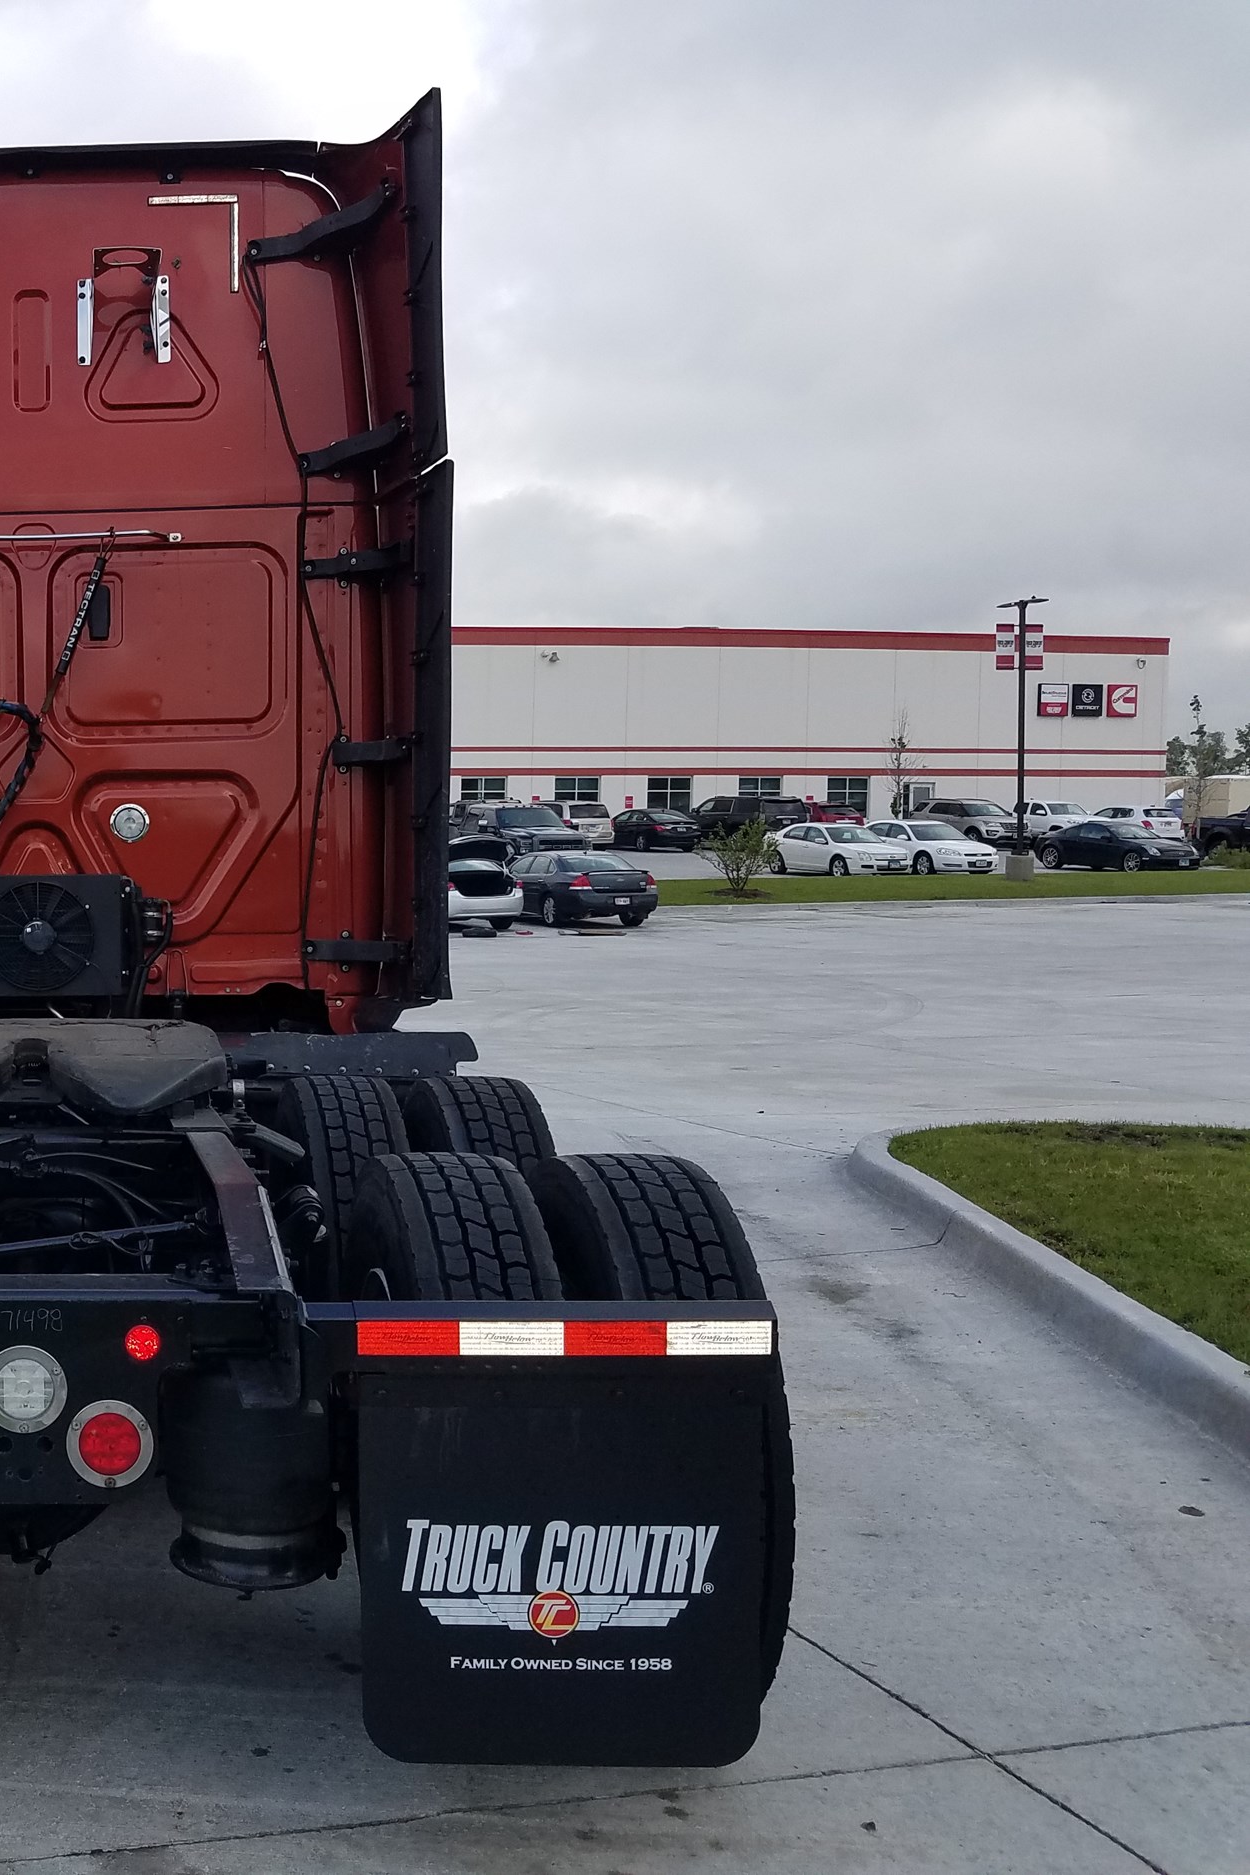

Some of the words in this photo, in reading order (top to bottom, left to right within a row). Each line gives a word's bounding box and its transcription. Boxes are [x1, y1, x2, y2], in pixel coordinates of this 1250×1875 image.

[66, 583, 96, 649] TECTRAN
[1112, 687, 1134, 704] Cummins
[401, 1519, 531, 1592] TRUCK
[535, 1520, 720, 1594] COUNTRY
[450, 1656, 508, 1669] FAMILY
[510, 1657, 572, 1670] OWNED
[575, 1657, 624, 1670] SINCE
[630, 1658, 673, 1671] 1958
